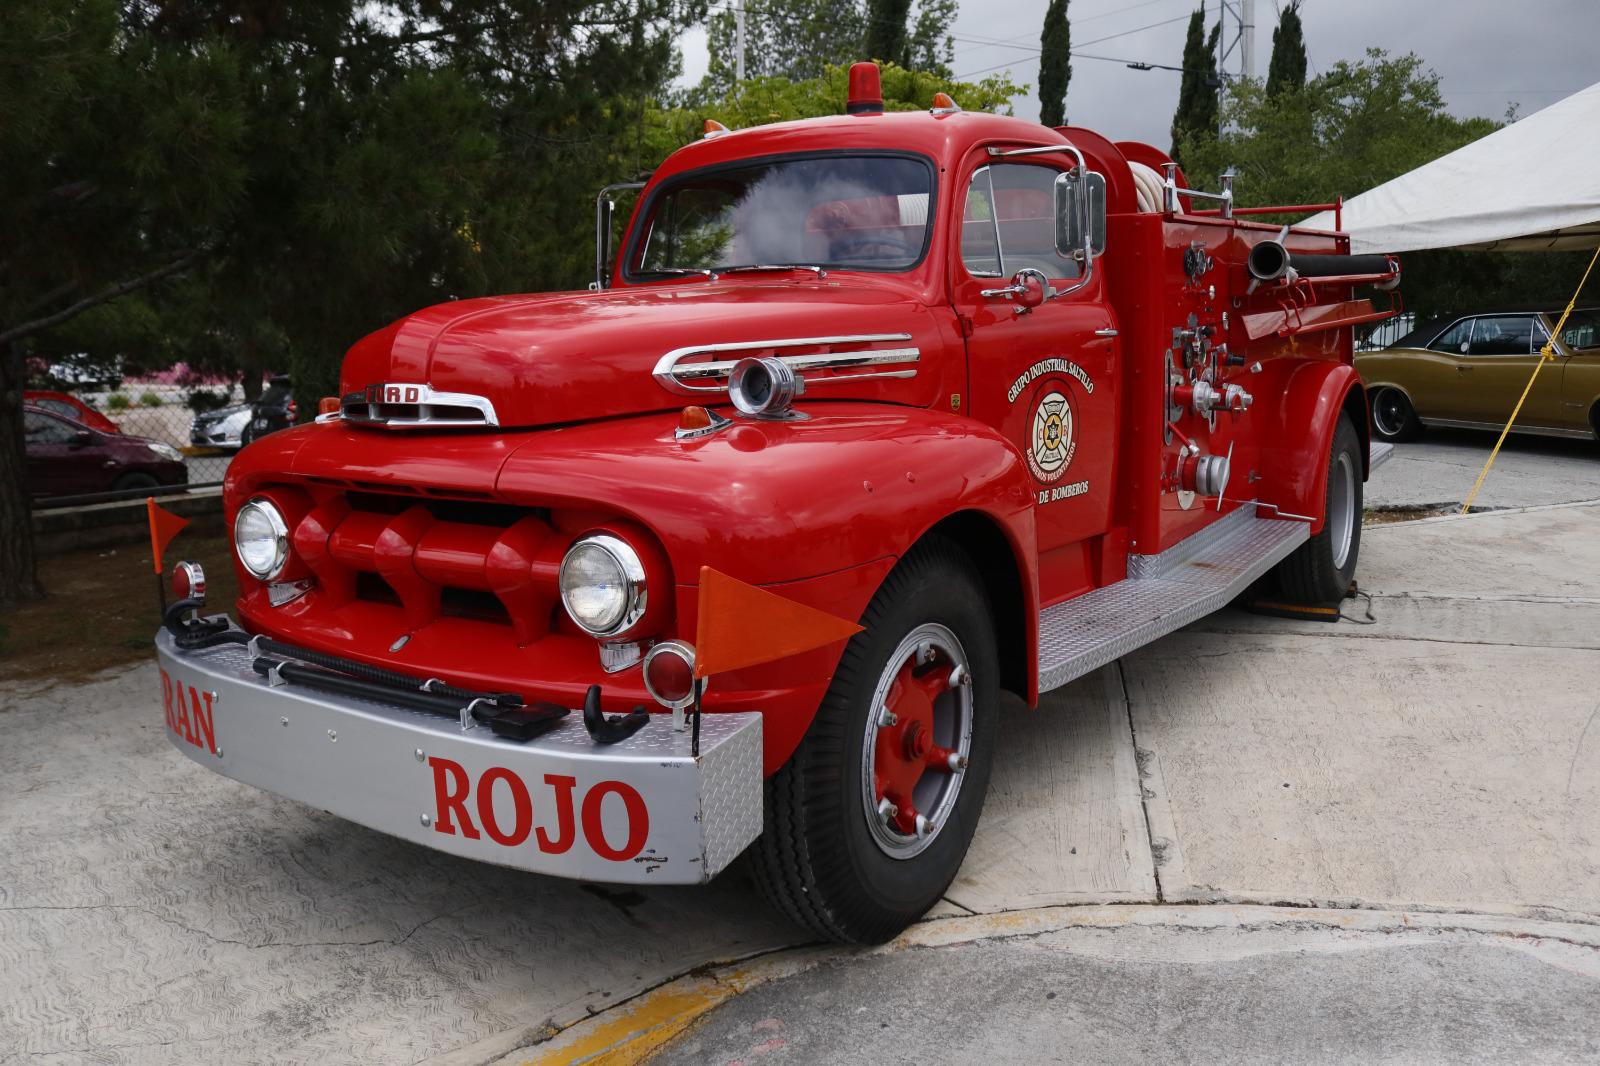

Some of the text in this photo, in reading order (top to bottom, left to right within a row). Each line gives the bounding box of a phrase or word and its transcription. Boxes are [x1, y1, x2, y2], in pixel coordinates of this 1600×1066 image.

[1008, 358, 1094, 403] GRUPO INDUSTRIAL SALTILLO
[1026, 441, 1076, 482] BOMBEROS VOLUNTARIOS
[1038, 490, 1050, 505] DE
[1051, 480, 1089, 501] BOMBEROS
[428, 757, 650, 862] ROJO
